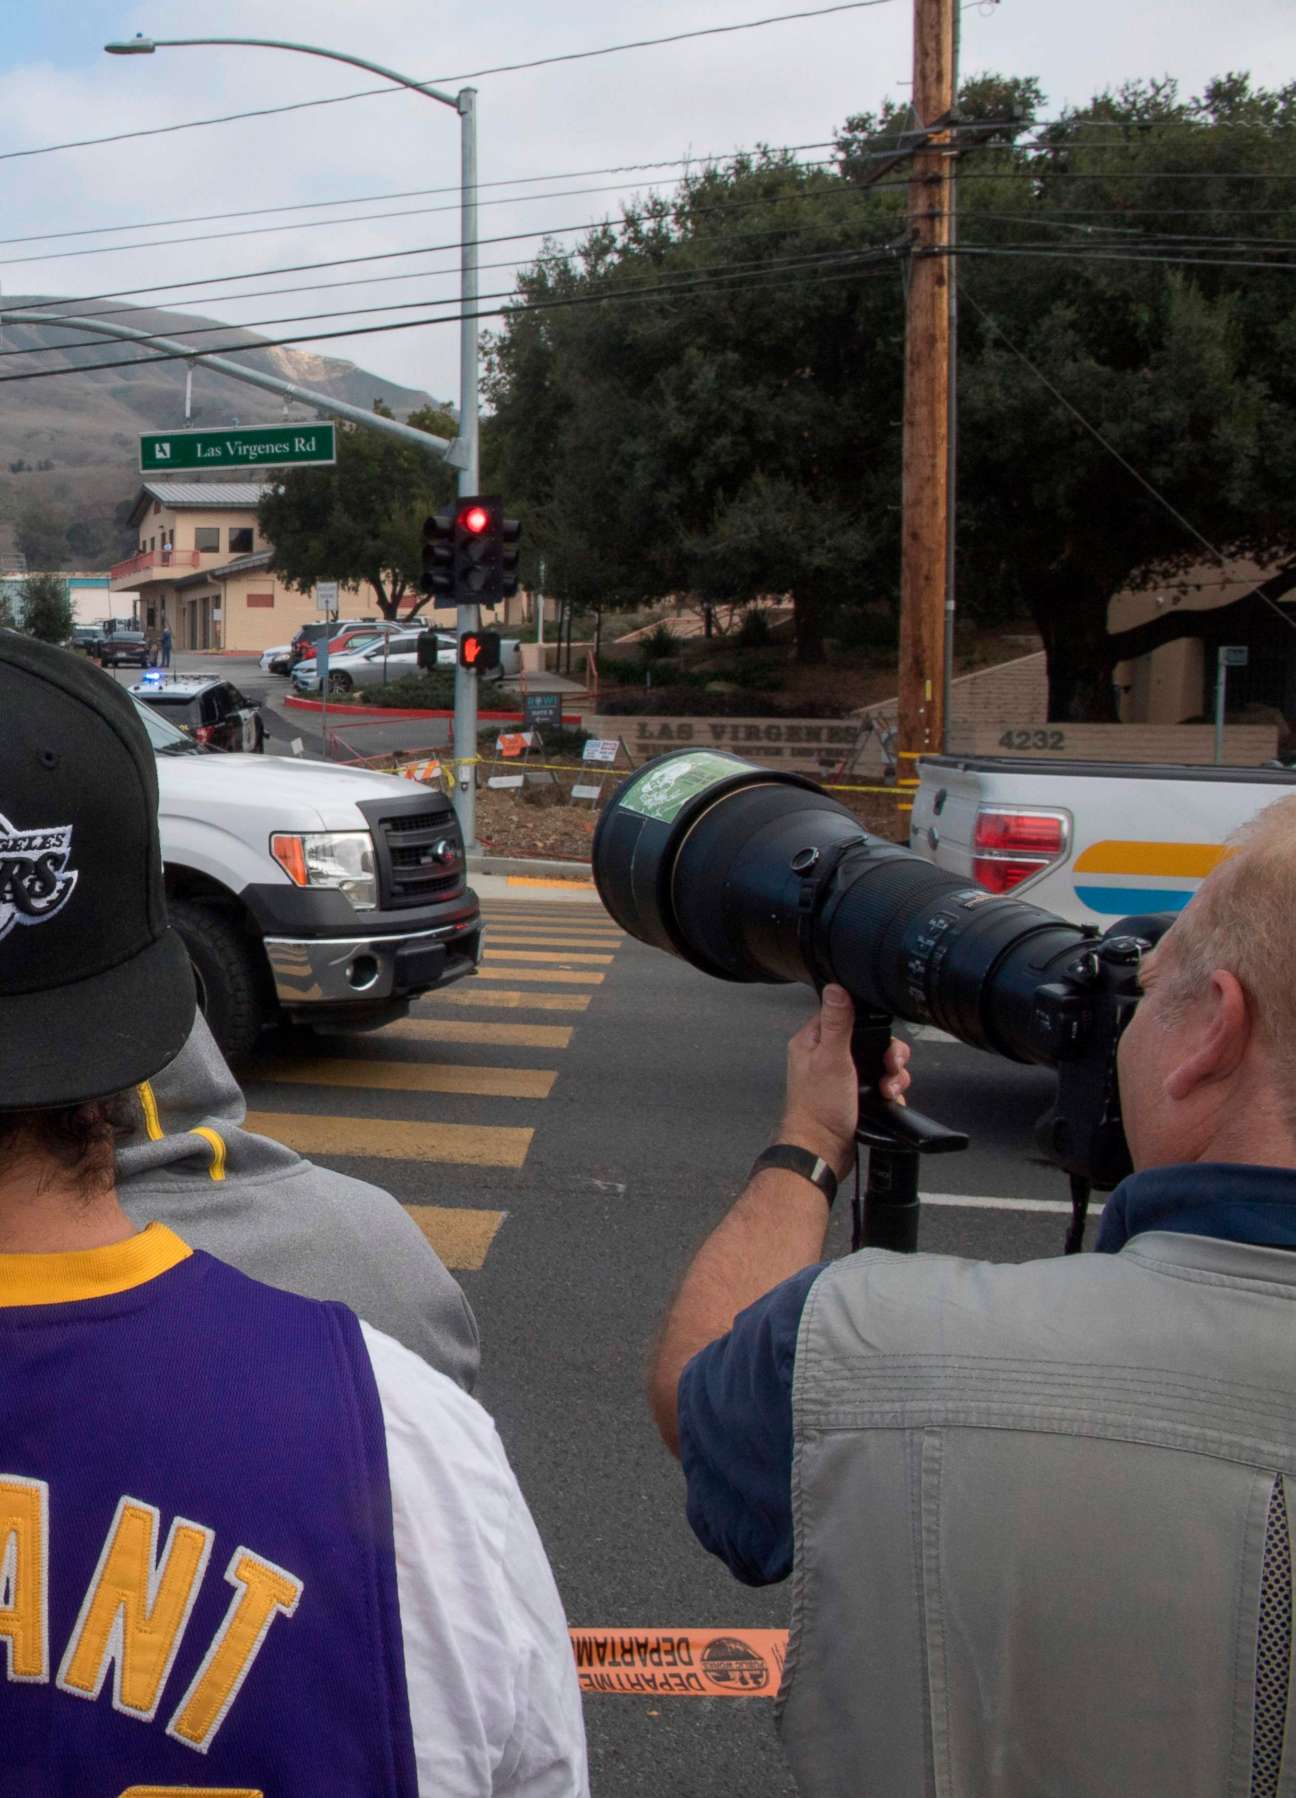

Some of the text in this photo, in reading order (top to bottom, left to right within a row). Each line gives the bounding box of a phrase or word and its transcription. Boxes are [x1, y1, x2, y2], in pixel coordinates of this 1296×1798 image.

[196, 436, 316, 460] Las Virgenes Rd
[636, 722, 858, 743] LAS VIRGENES
[998, 730, 1065, 751] 4232
